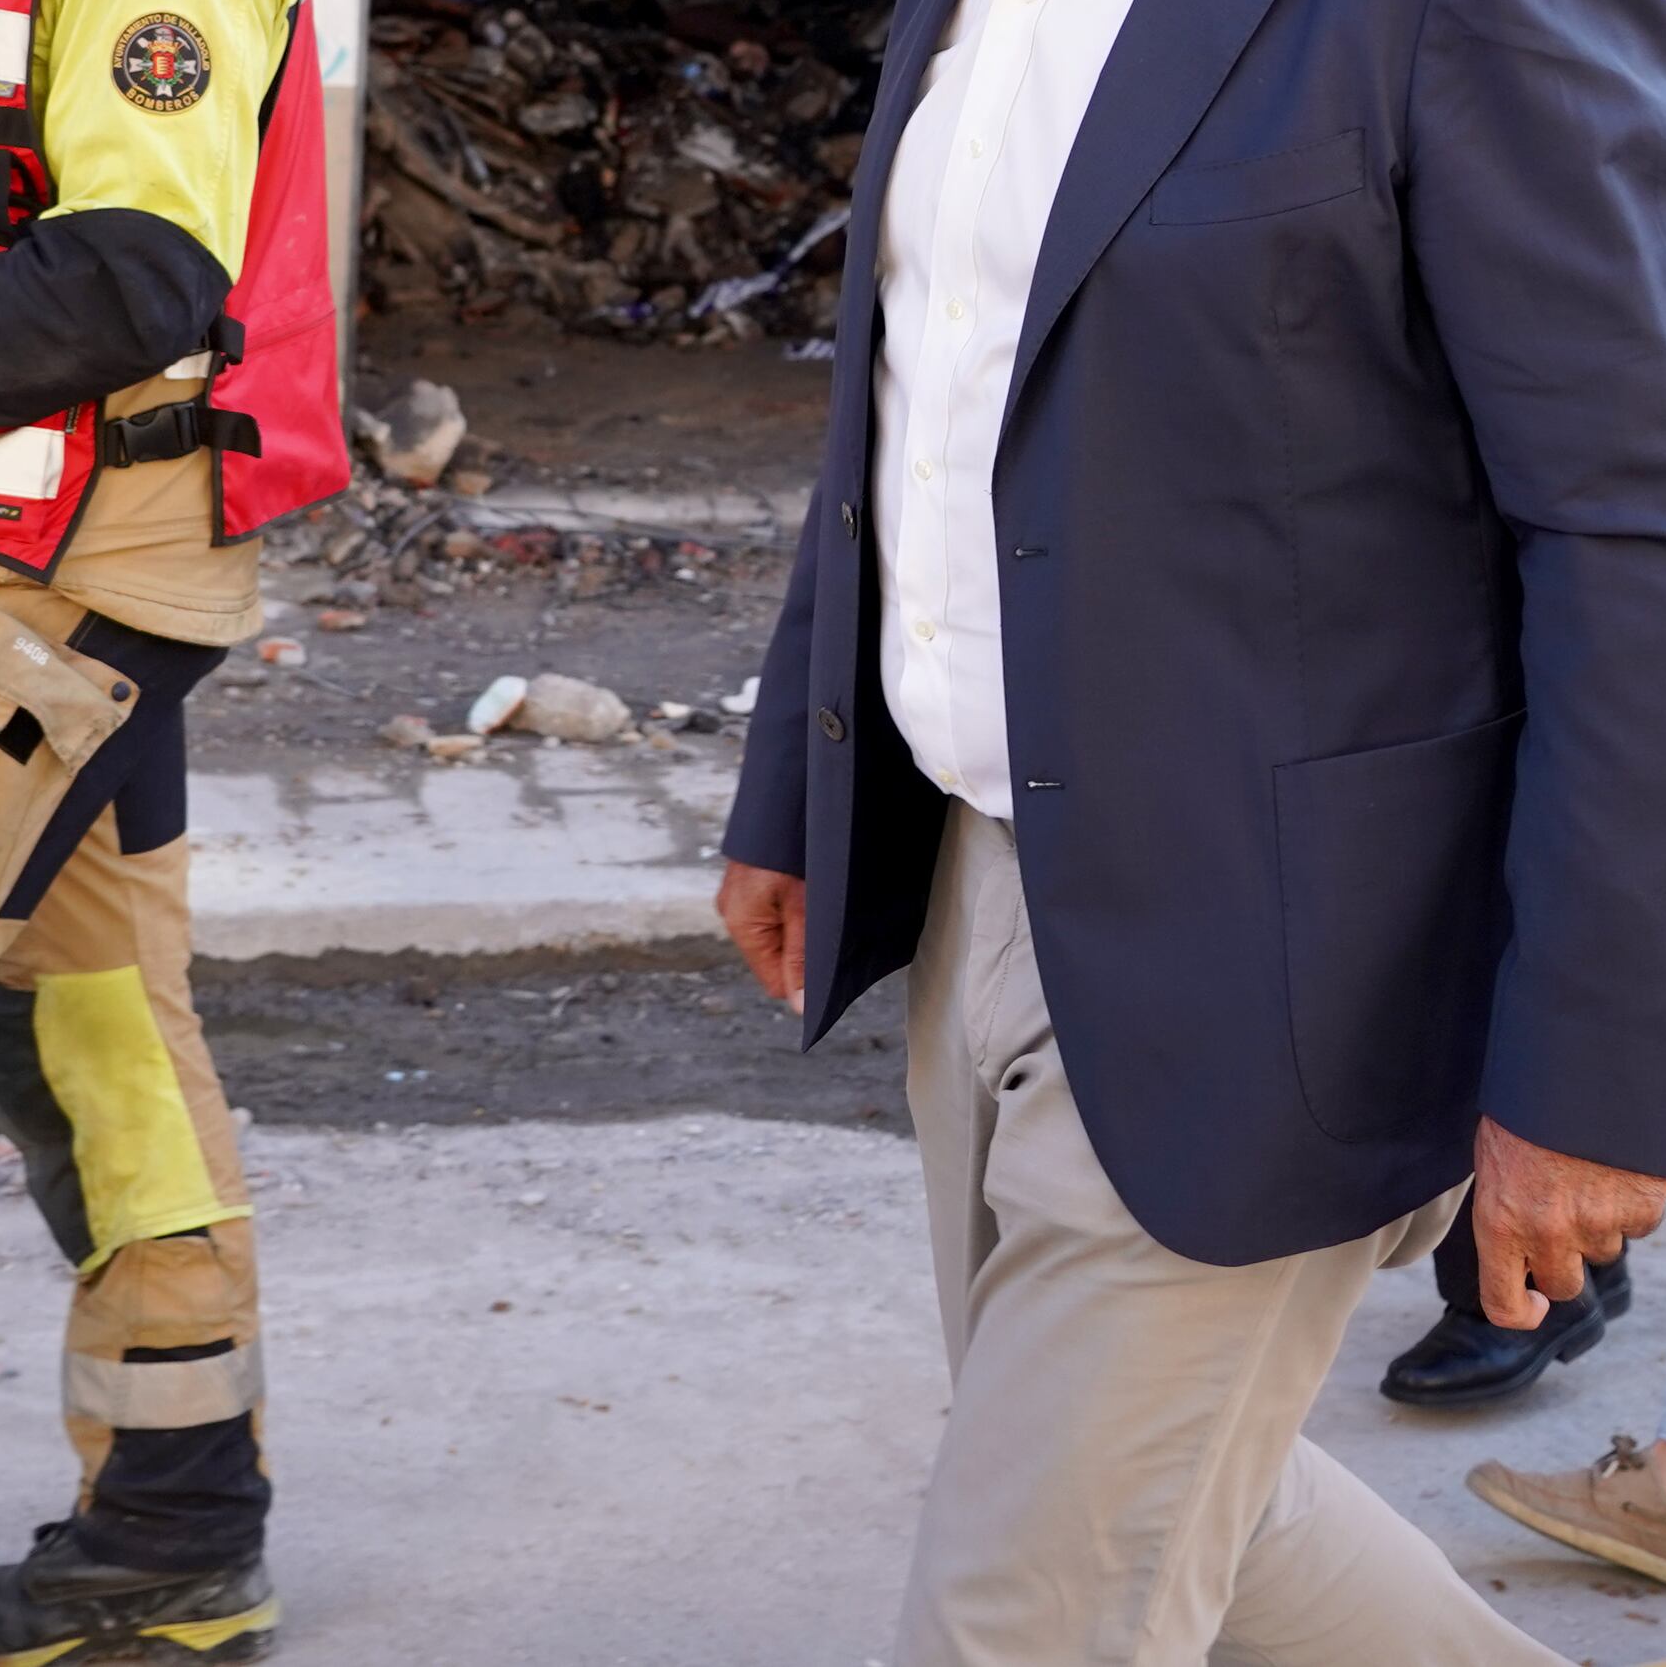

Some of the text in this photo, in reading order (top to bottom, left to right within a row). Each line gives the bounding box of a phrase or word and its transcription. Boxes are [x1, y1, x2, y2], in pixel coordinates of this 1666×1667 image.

[114, 14, 210, 71] AYUNTAMIENTO DE VALLADOLID
[127, 88, 200, 111] BOMBEROS
